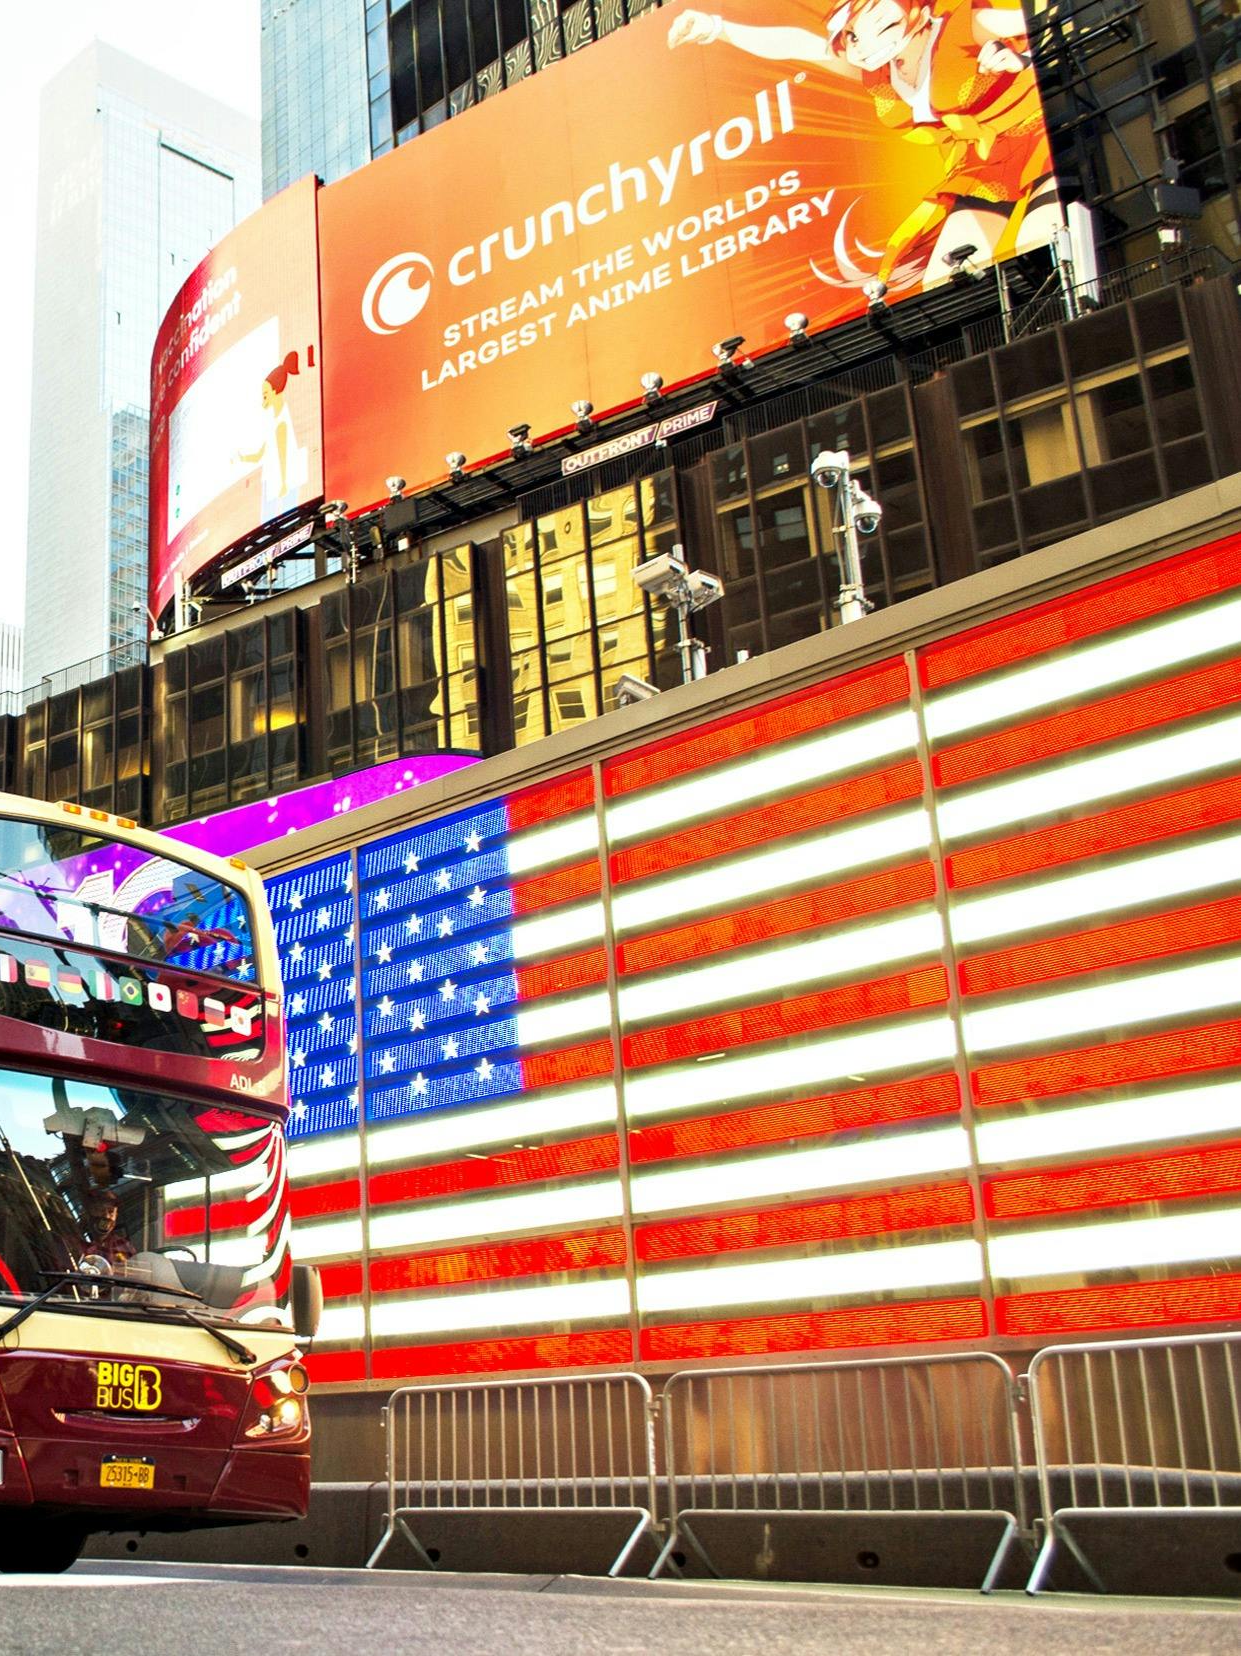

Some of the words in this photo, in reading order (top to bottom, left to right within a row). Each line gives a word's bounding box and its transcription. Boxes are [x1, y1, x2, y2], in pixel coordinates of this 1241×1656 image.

[448, 80, 795, 286] crunchyroll
[421, 313, 557, 392] LARGEST
[566, 263, 672, 328] ANIME
[681, 189, 835, 277] LIBRARY
[443, 276, 564, 347] STREAM
[572, 245, 634, 288] THE
[642, 170, 801, 256] WORLD'S
[565, 428, 654, 472] OUTFRONT
[663, 406, 710, 435] PRIME
[97, 1386, 133, 1409] BUS
[98, 1362, 134, 1387] BIG
